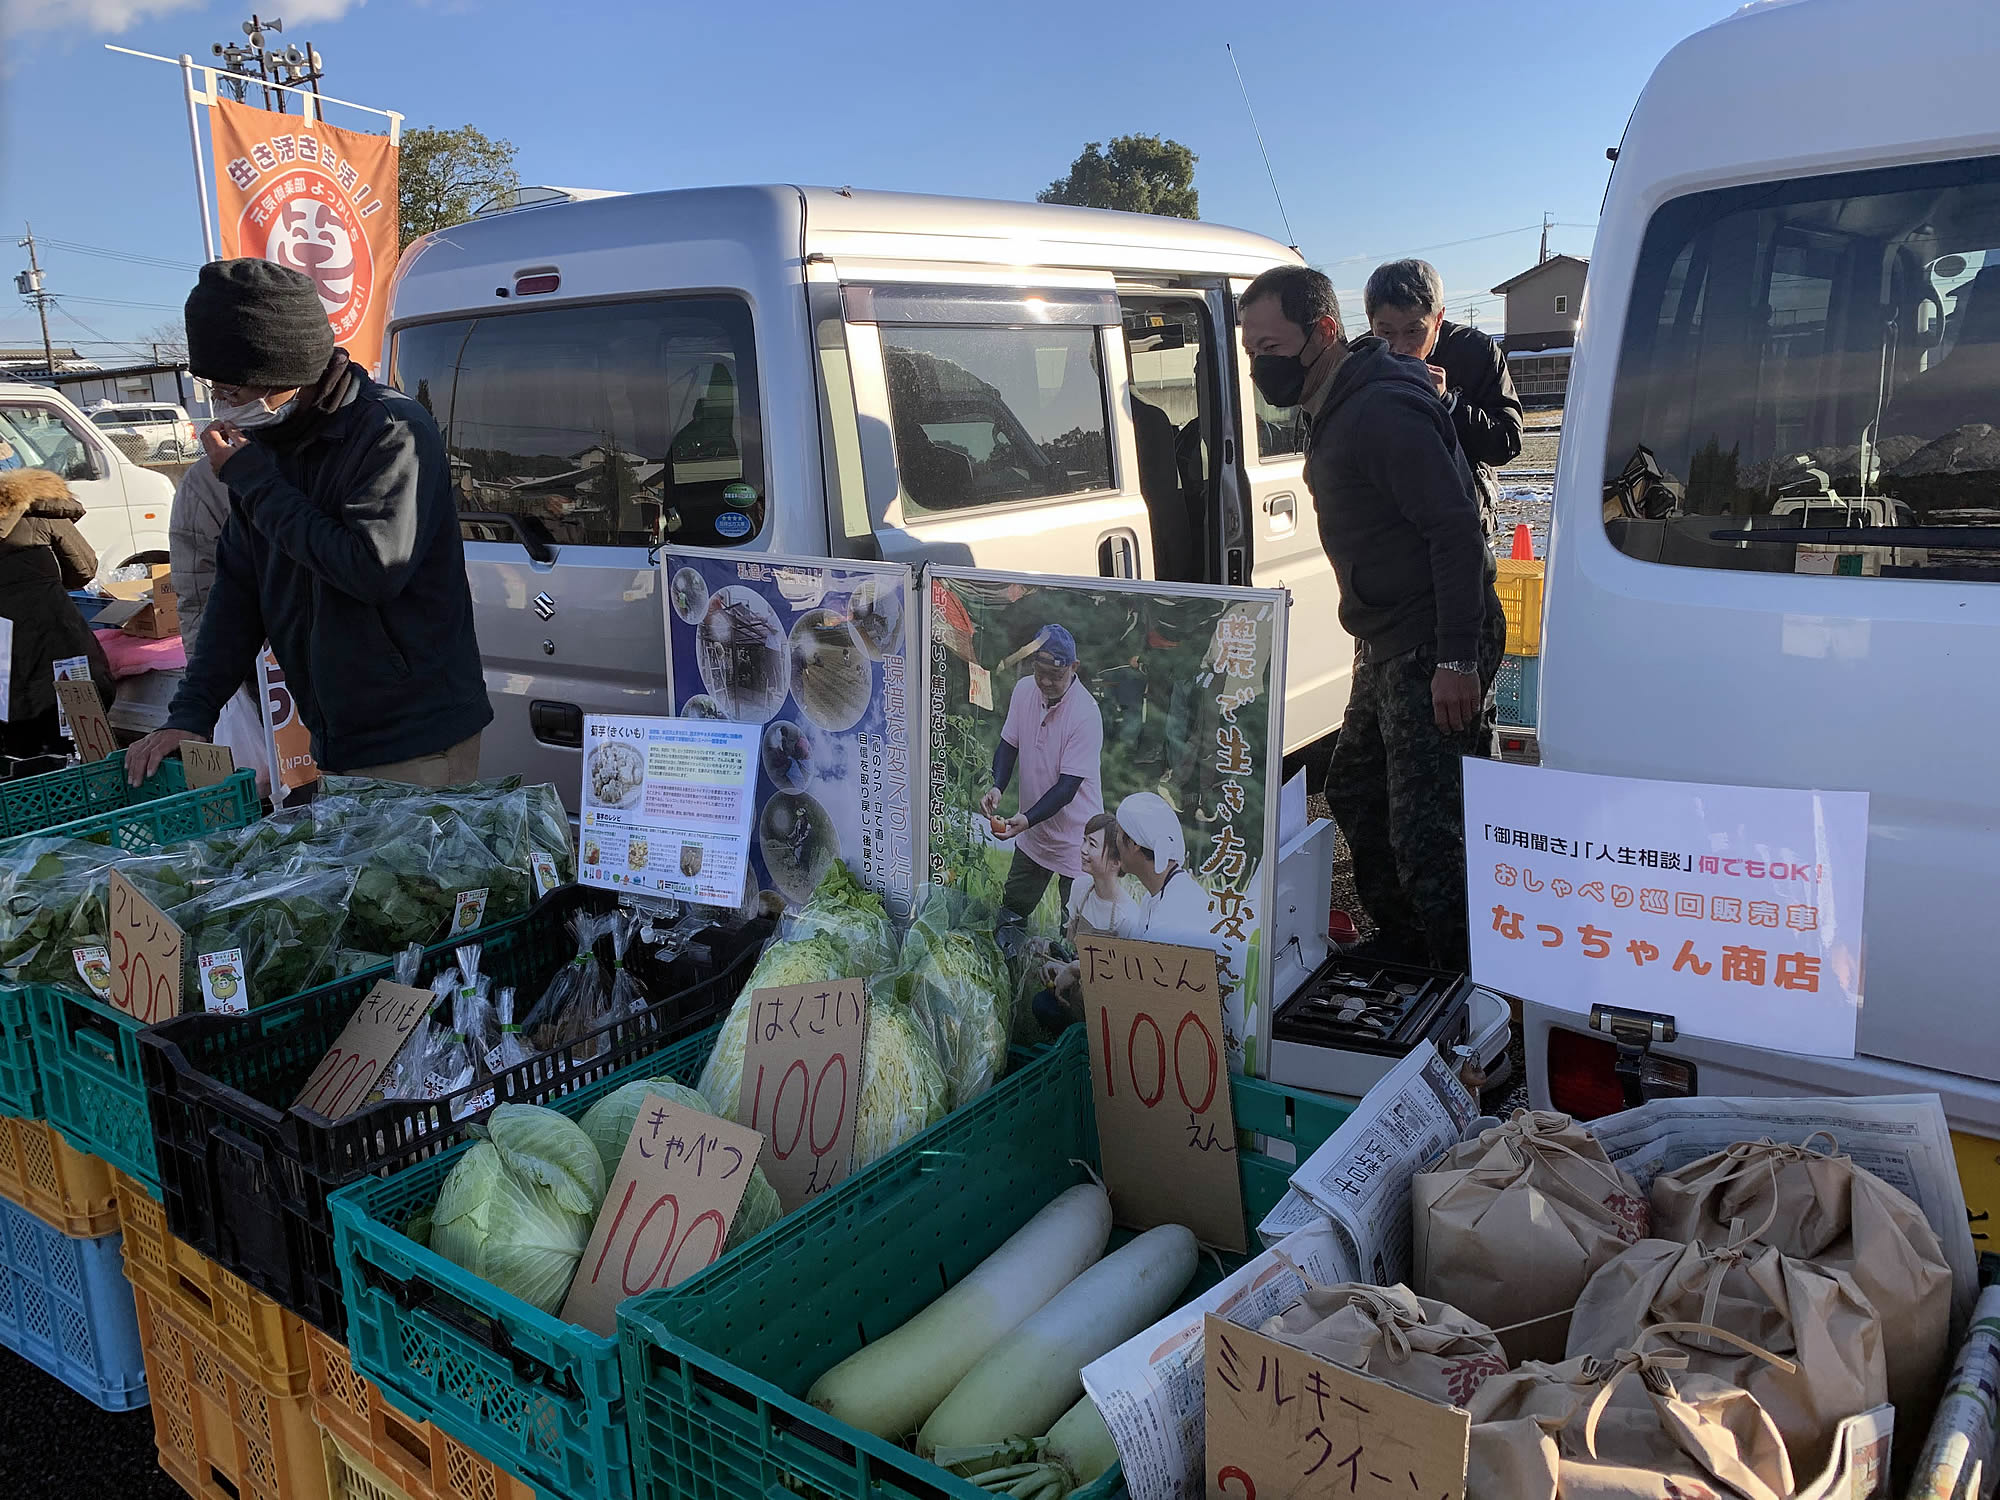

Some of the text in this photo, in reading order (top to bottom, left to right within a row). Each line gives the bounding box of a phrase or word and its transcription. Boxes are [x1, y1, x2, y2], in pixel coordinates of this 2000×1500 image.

[1494, 863, 1820, 932] おしゃべり巡回販売車
[112, 930, 175, 1024] 300
[1082, 945, 1208, 992] だいこん
[1491, 904, 1822, 993] なっちゃん商店
[358, 991, 420, 1033] きくいも
[754, 991, 861, 1045] はくさい
[1100, 1004, 1219, 1115] 100
[640, 1106, 744, 1180] きゃべつ
[751, 1053, 848, 1161] 100
[1185, 1111, 1236, 1153] えん
[591, 1179, 727, 1297] 100
[1217, 1333, 1371, 1423] ミルキー
